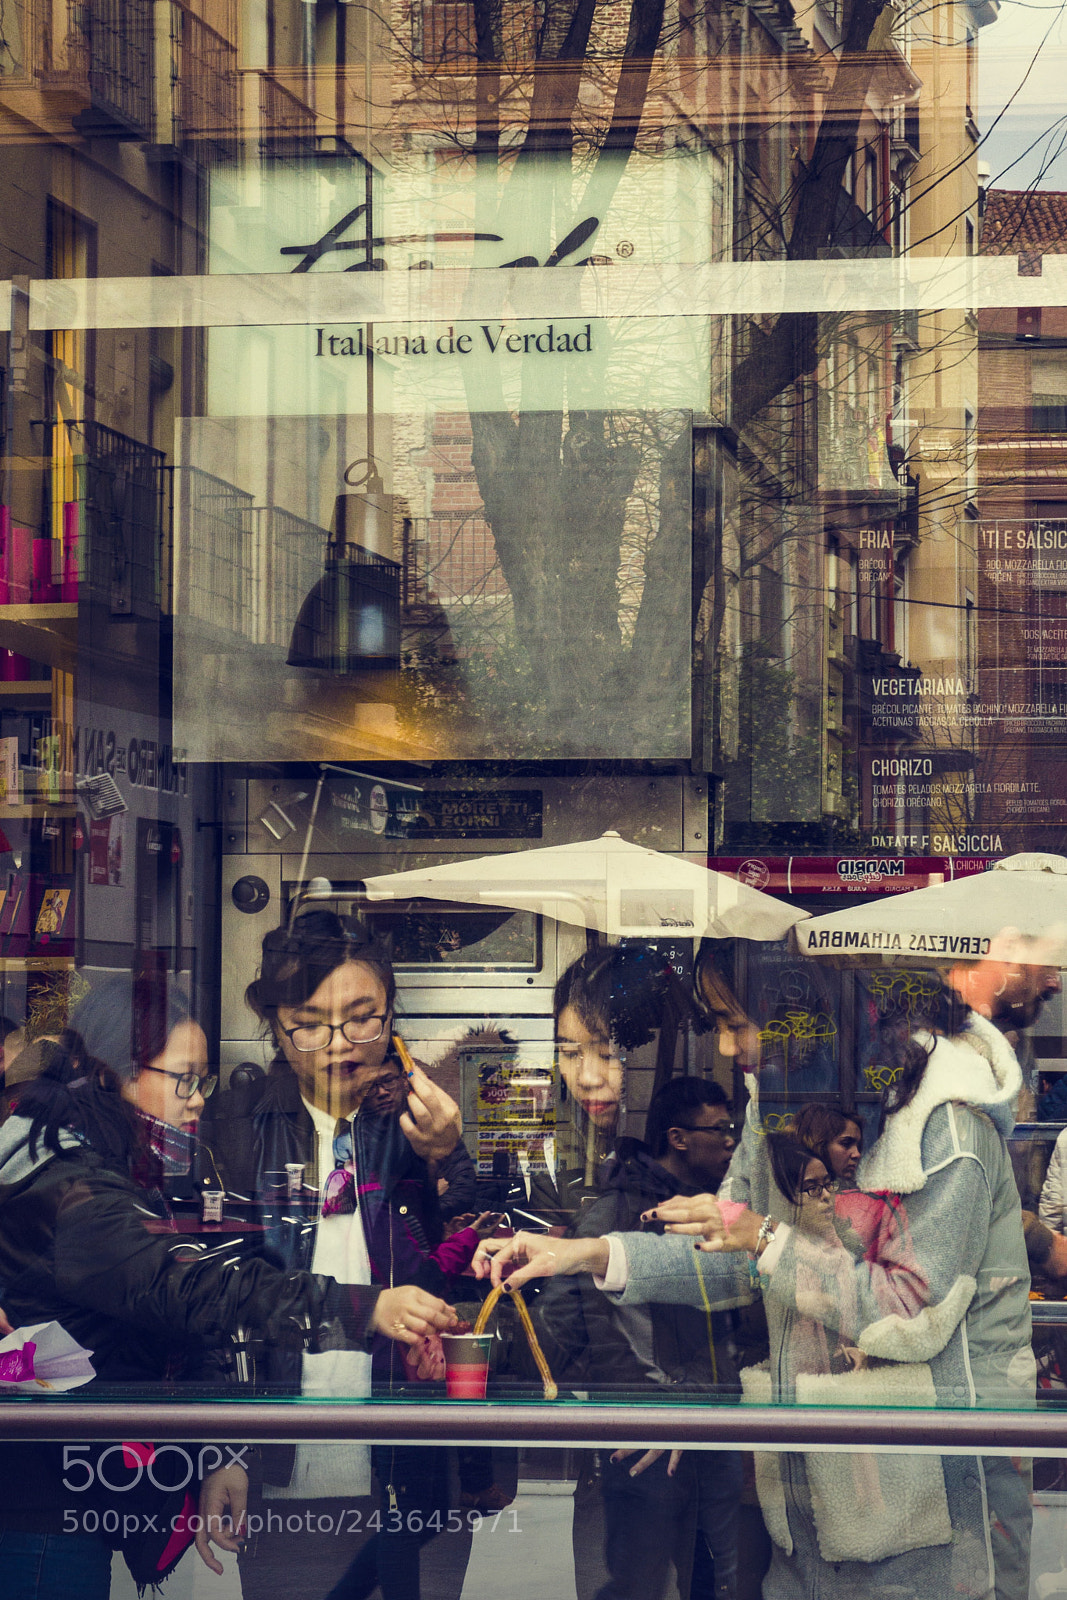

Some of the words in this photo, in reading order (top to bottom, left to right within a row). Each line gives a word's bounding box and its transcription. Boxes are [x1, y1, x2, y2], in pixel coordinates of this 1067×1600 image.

[314, 328, 428, 357] Italana
[436, 326, 473, 355] de
[480, 323, 593, 354] Verdad
[1004, 530, 1013, 549] E
[1004, 559, 1054, 570] MOZZARELLA
[872, 679, 965, 696] VEGETARIANA
[872, 703, 900, 715] BRÉCOL
[937, 704, 971, 714] TOMATES
[1008, 703, 1057, 714] MOZZARELLA
[872, 716, 913, 727] ACEITUNAS
[872, 759, 933, 776] CHORIZO
[872, 784, 906, 795] TOMATES
[943, 783, 992, 794] MOZZARELLA
[442, 803, 528, 815] MORETTI
[442, 815, 500, 827] FORNI
[933, 835, 1003, 852] SALSICCIA
[944, 860, 984, 870] SALCHICHA
[669, 950, 676, 960] 9
